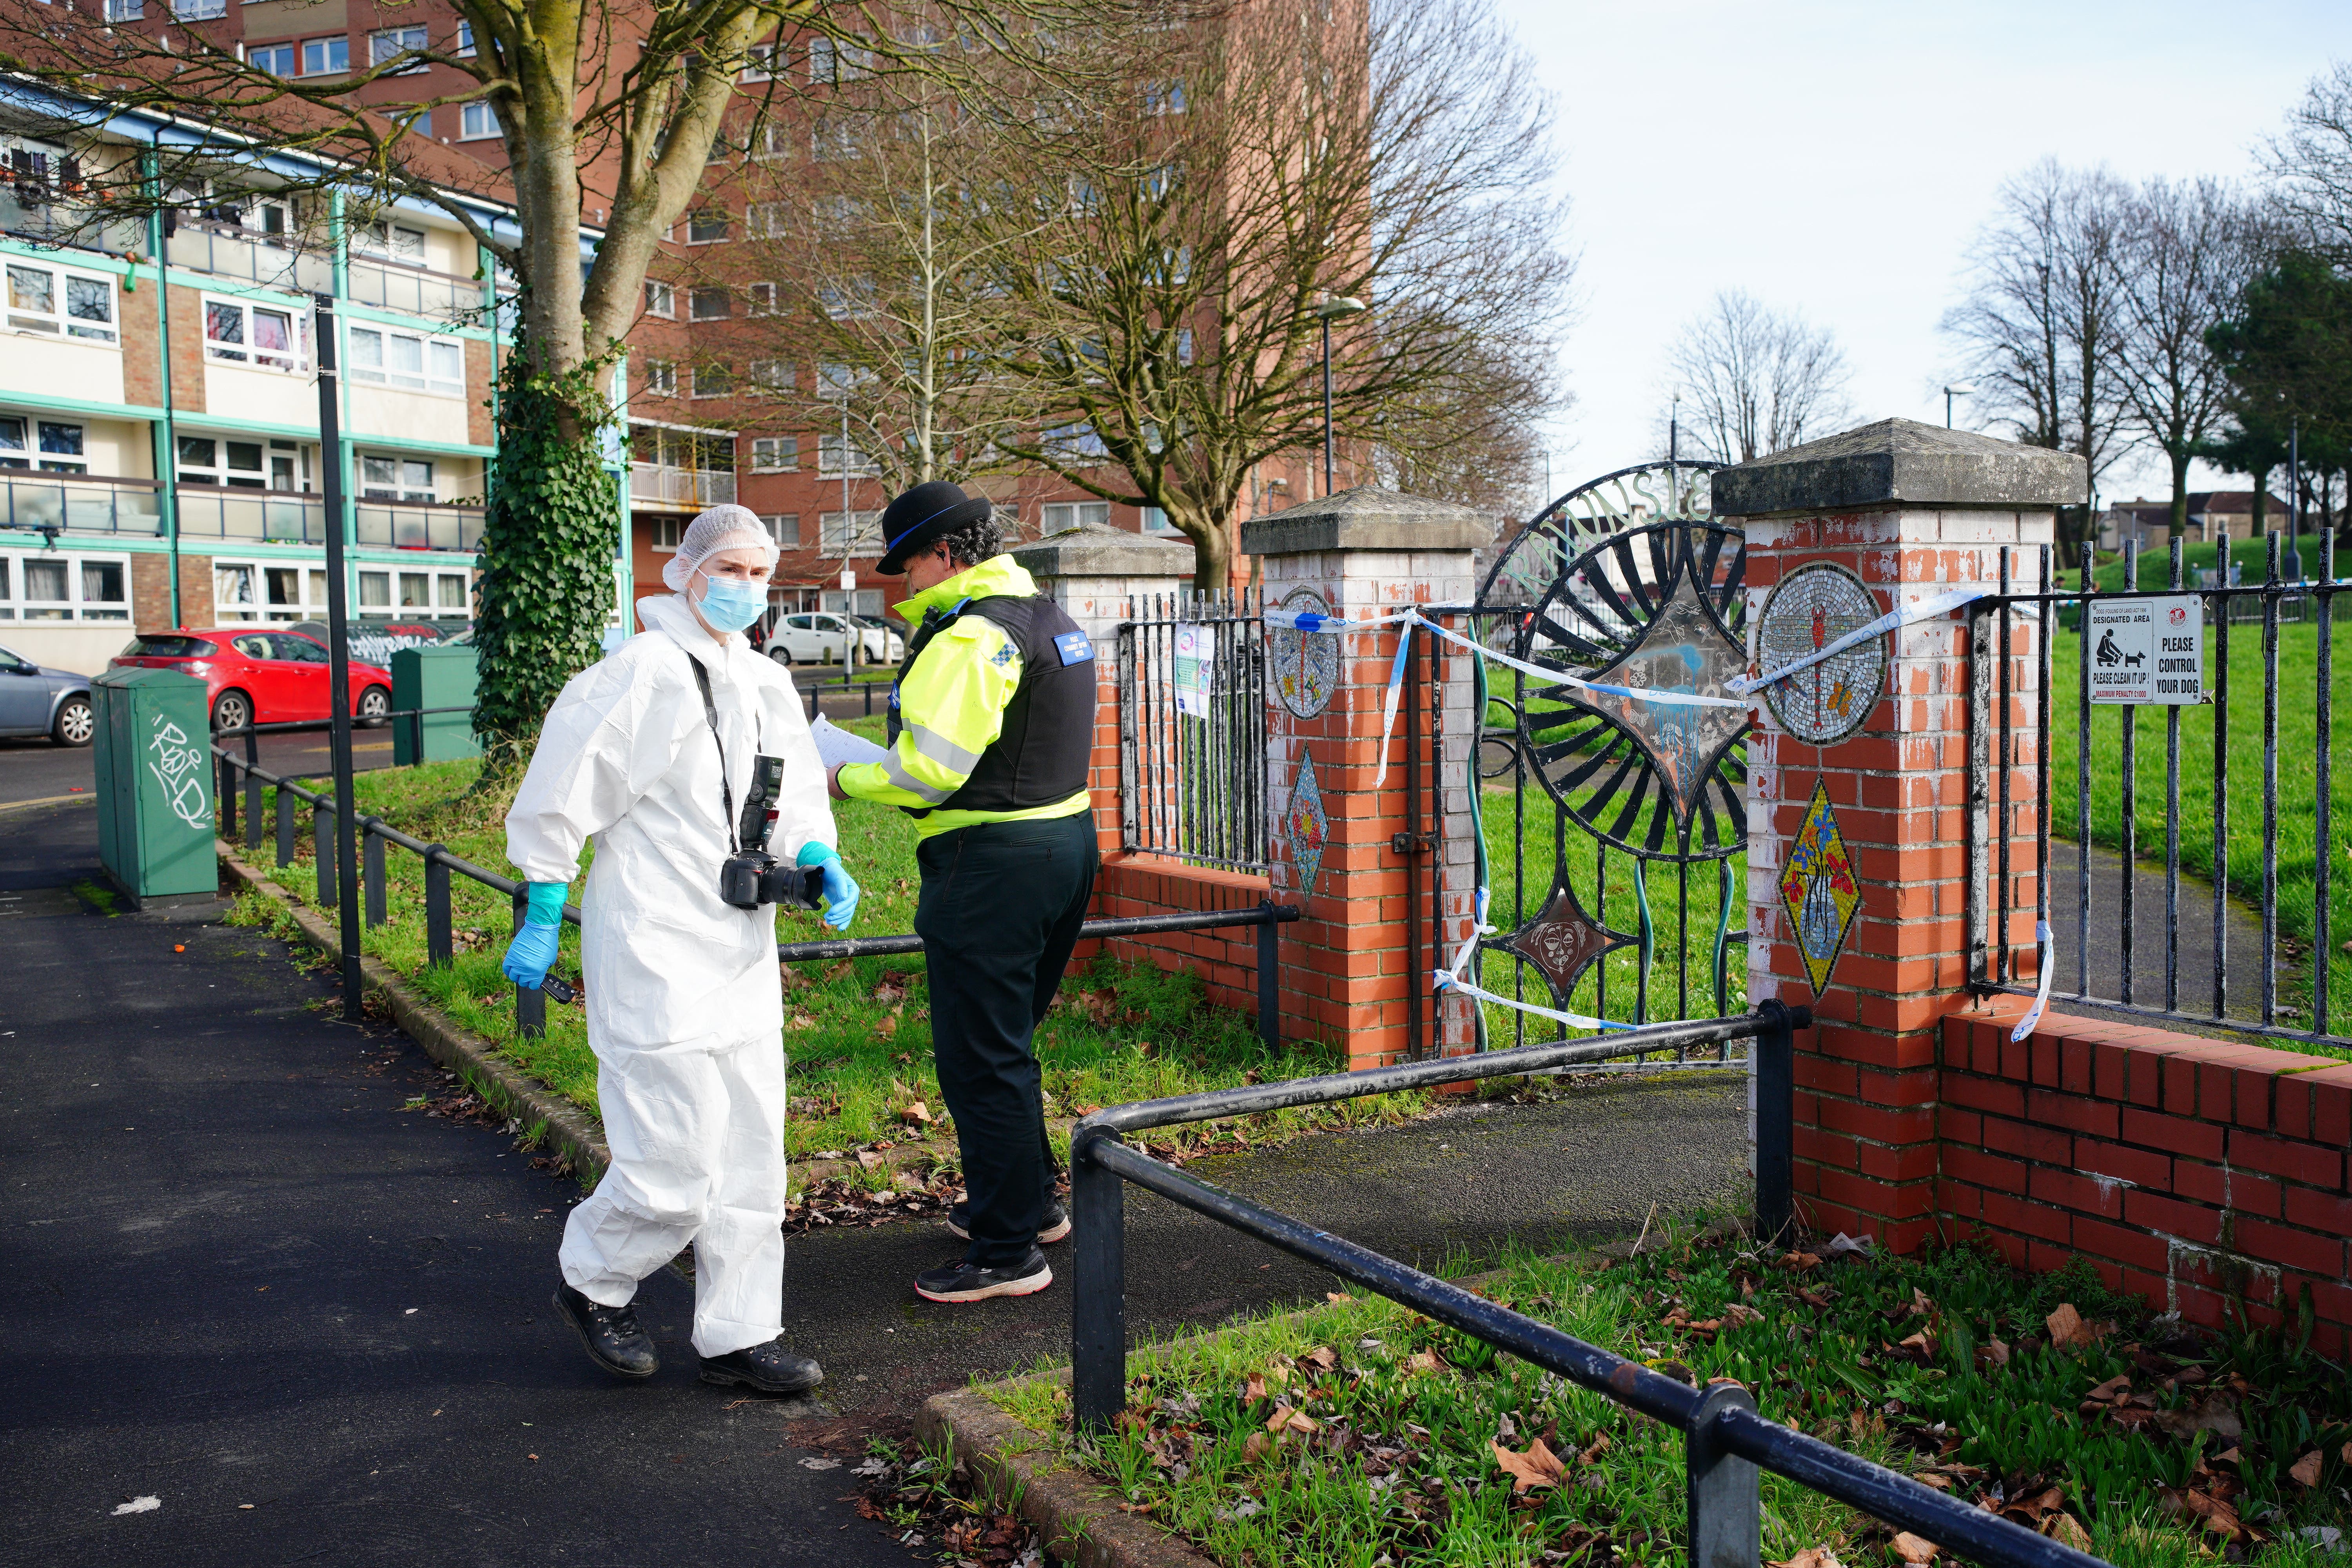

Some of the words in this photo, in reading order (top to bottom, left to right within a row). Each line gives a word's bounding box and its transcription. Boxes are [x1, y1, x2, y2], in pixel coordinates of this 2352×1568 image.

[1501, 469, 1724, 604] RAWNSLE
[2166, 603, 2189, 613] BRISTOL
[2173, 619, 2189, 631] COUNCIL
[2162, 637, 2193, 652] PLEASE
[2159, 658, 2197, 673] CONTROL
[2093, 672, 2112, 684] PLEASE
[2113, 672, 2131, 684] CLEAN
[2132, 672, 2137, 684] IT
[2138, 672, 2146, 684] UP
[2156, 679, 2178, 693] YOUR
[2181, 679, 2198, 693] DOG
